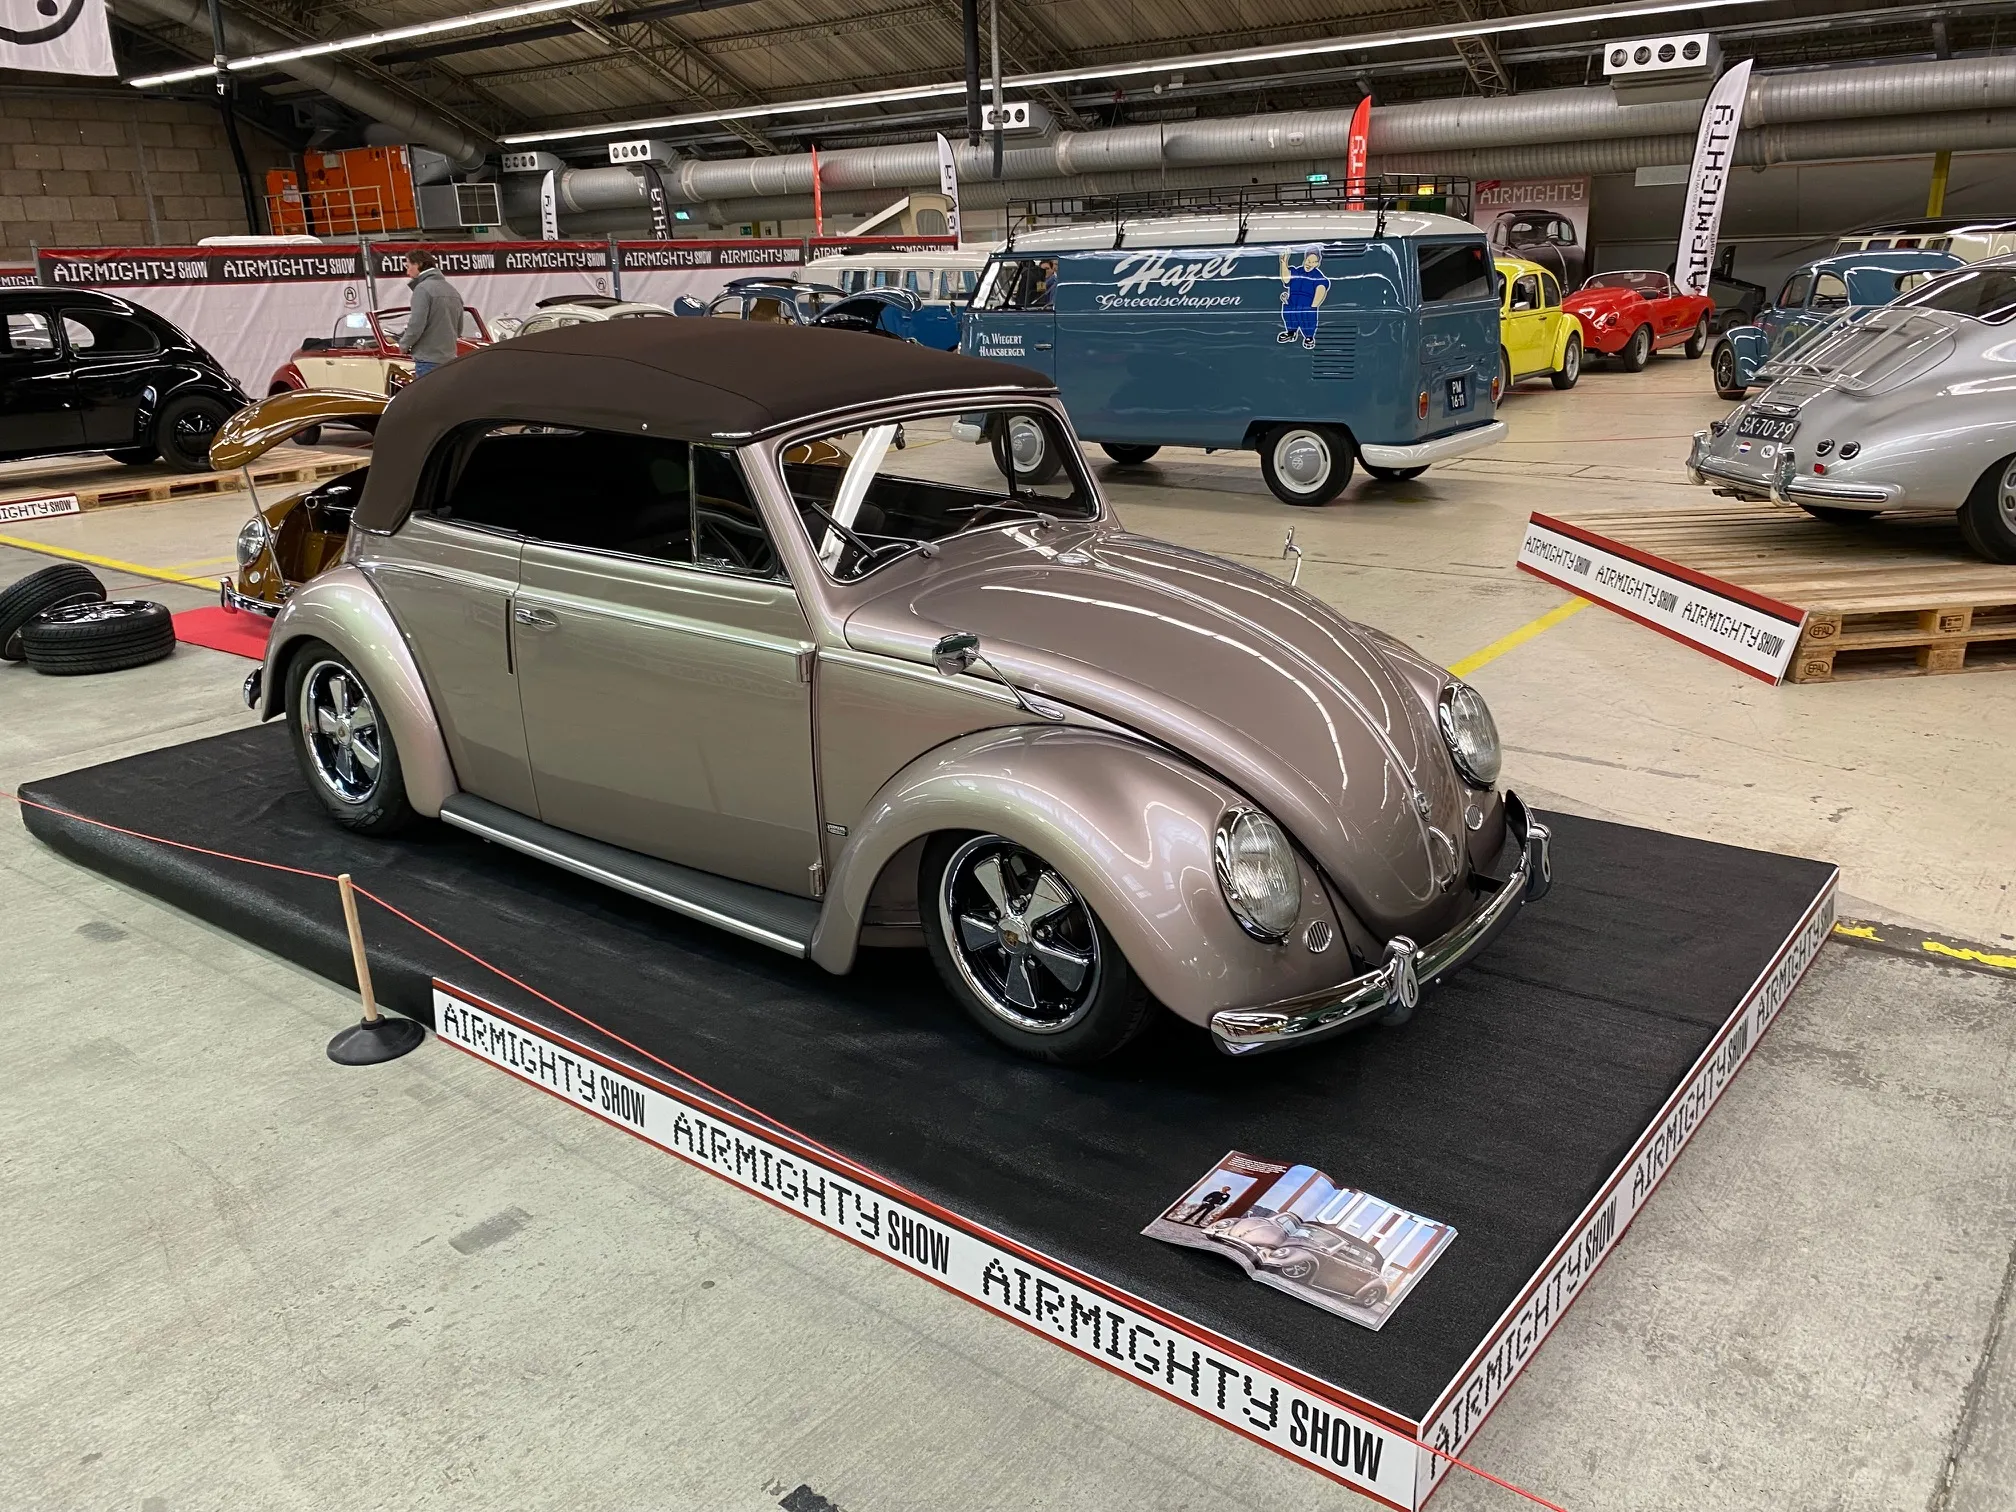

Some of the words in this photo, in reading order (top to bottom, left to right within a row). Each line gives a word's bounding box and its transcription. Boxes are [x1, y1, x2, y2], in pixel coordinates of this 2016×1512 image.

[1480, 183, 1584, 205] AIRMIGHTY
[1687, 105, 1734, 289] AIRMIGHTY
[471, 254, 495, 270] SHOW
[505, 252, 587, 269] AIRMIGHTY
[587, 251, 606, 267] SHOW
[624, 251, 694, 266] AIRMIGHTY
[694, 250, 712, 265] SHOW
[720, 248, 782, 264] AIRMIGHTY
[783, 248, 800, 262] SHOW
[53, 262, 175, 282] AIRMIGHTY
[178, 261, 208, 279] SHOW
[223, 258, 328, 278] AIRMIGHTY
[330, 257, 355, 274] SHOW
[1113, 247, 1244, 296] Hazet
[1095, 293, 1243, 311] Gereedschappen
[49, 499, 72, 513] SHOW
[1524, 535, 1575, 570] AIRMIGHTY
[1574, 555, 1592, 577] SHOW
[1595, 565, 1659, 605] AIRMIGHTY
[1657, 589, 1679, 613] SHOW
[1681, 601, 1760, 648] AIRMIGHTY
[1757, 631, 1786, 658] SHOW
[1812, 625, 1831, 636] EPAL
[1808, 664, 1828, 674] EPAL
[1431, 1241, 1582, 1480] AIRMIGHTY
[1584, 1196, 1617, 1272] SHOW
[1631, 1046, 1726, 1209] AIRMIGHTY
[1727, 1015, 1749, 1074] SHOW
[1756, 913, 1820, 1033] AIRMIGHTY
[444, 1003, 595, 1101] AIRMIGHTY
[600, 1075, 646, 1128] SHOW
[673, 1111, 880, 1240] AIRMIGHTY
[887, 1210, 950, 1275] SHOW
[982, 1257, 1279, 1432] AIRMIGHTY
[1289, 1398, 1384, 1484] SHOW
